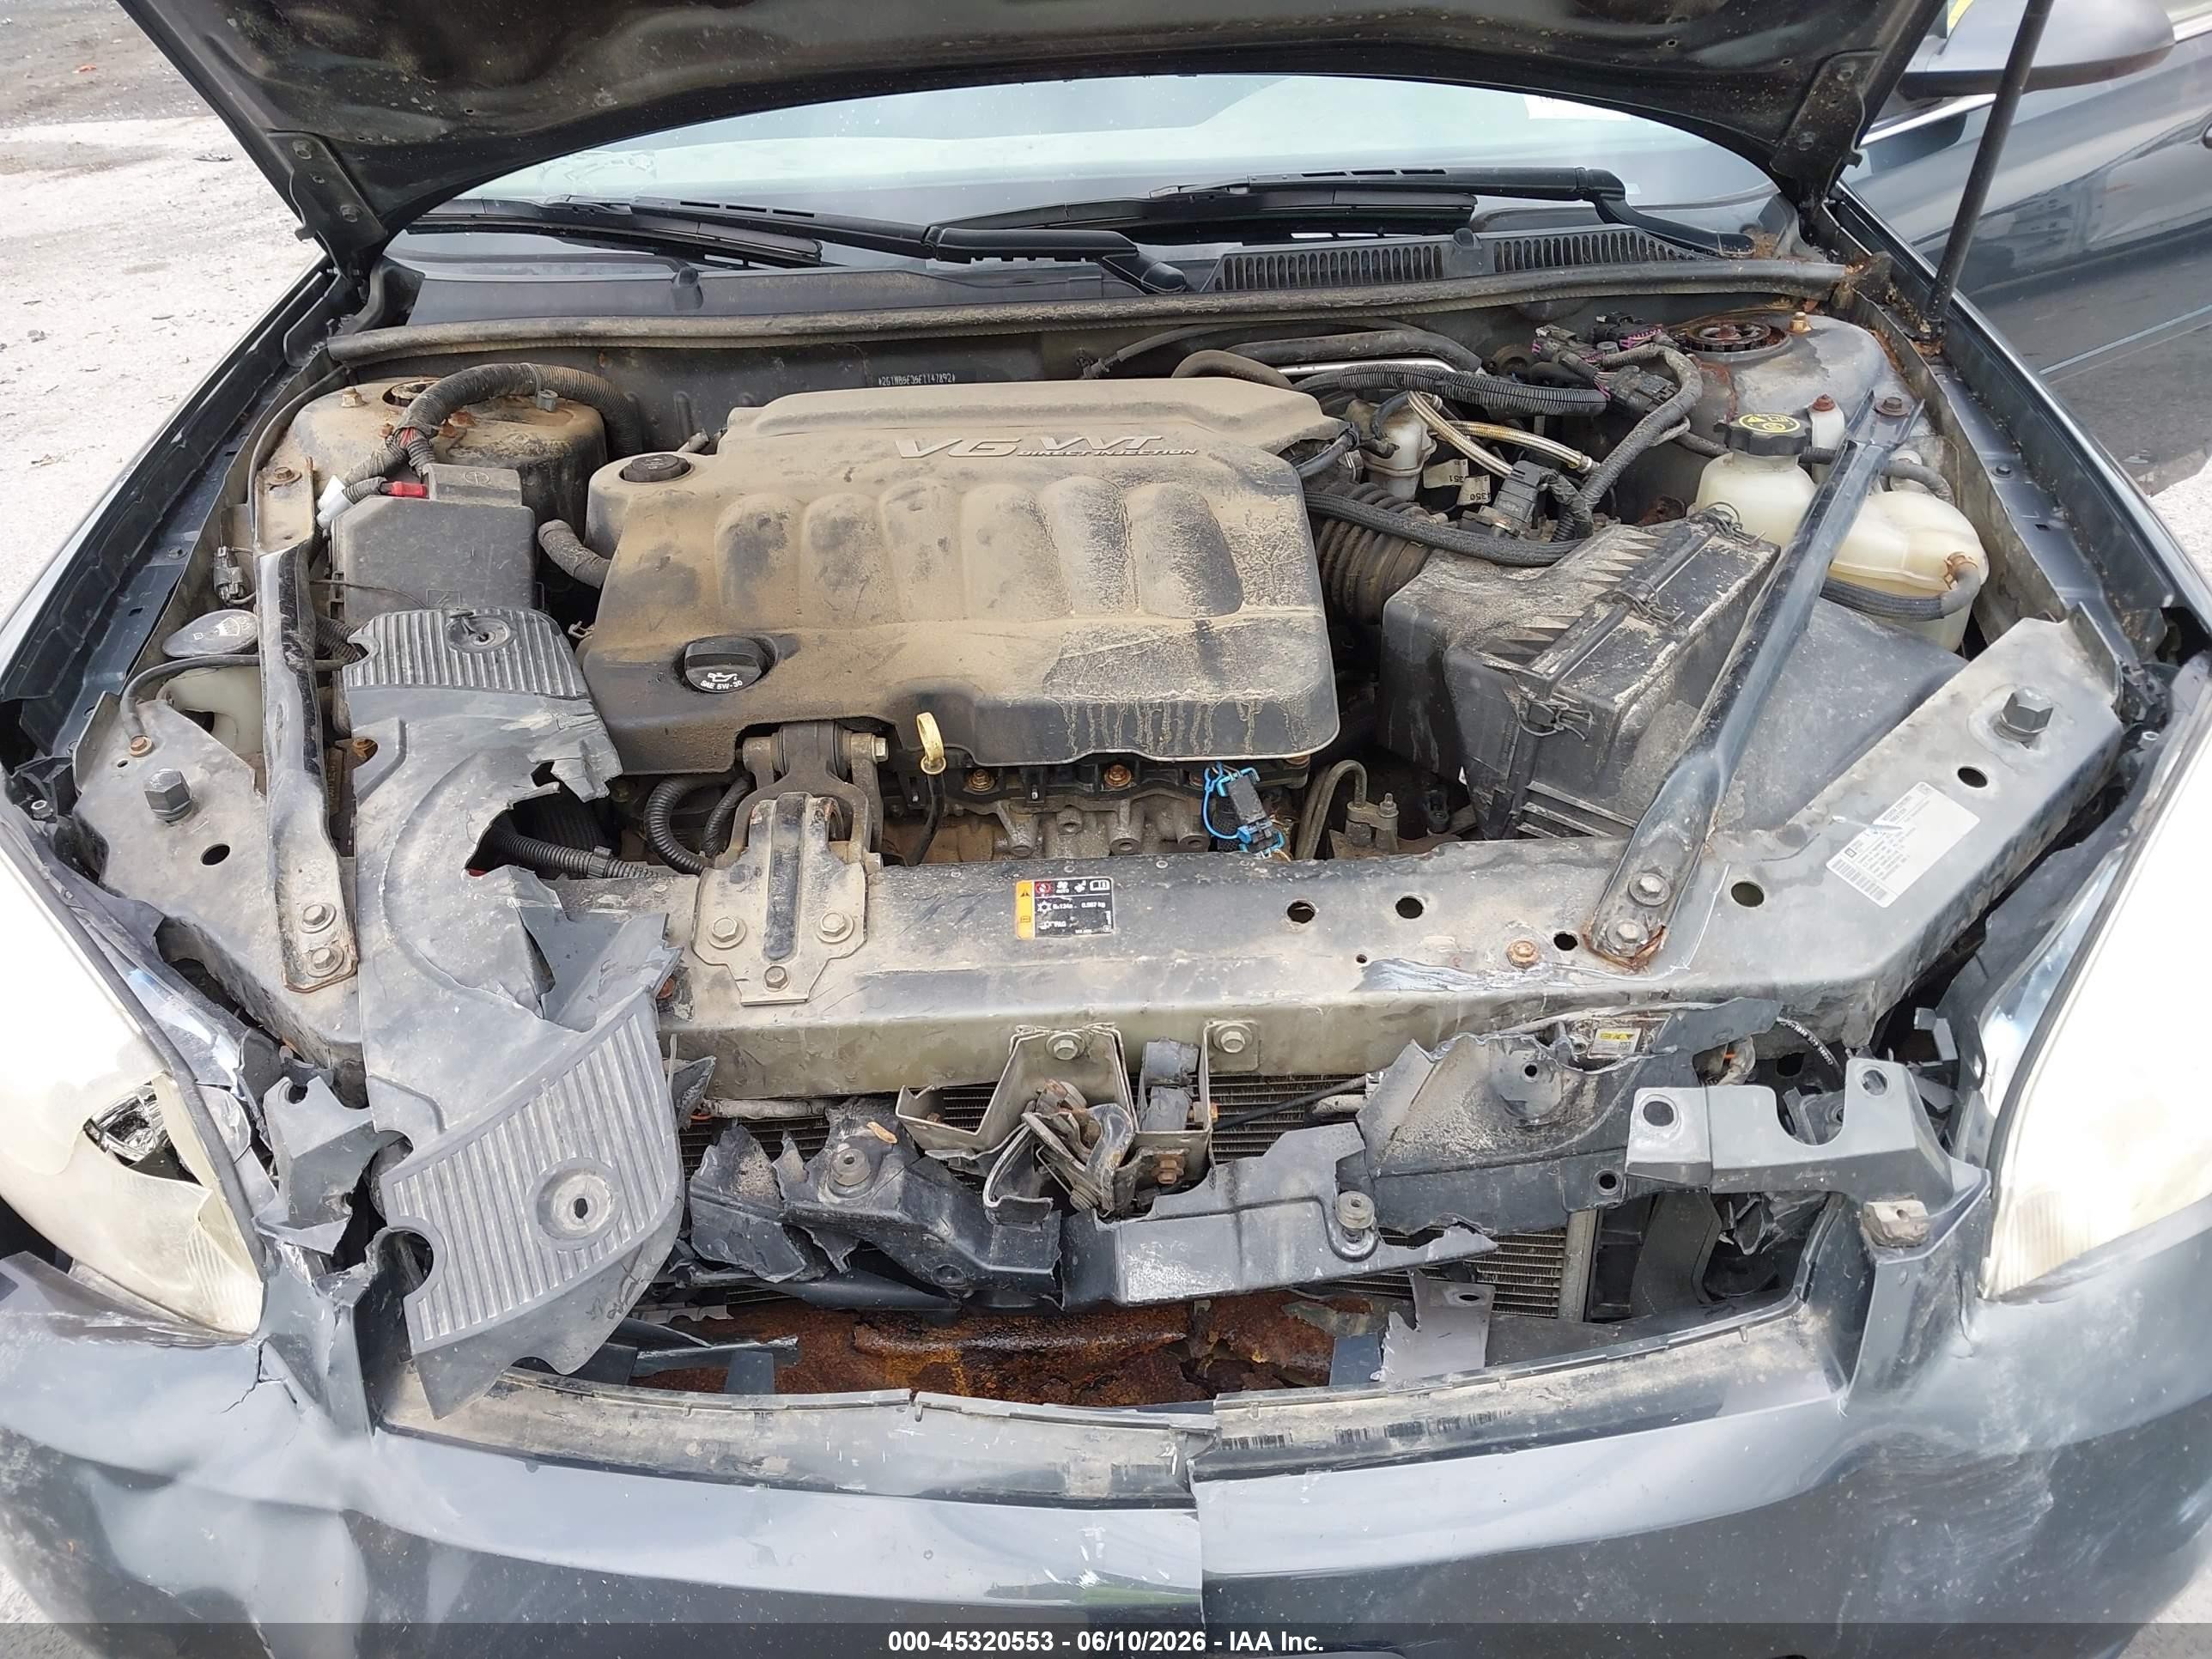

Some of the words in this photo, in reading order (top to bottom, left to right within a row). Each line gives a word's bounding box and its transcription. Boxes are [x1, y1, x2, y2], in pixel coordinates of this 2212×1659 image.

[895, 438, 1022, 459] V6
[1039, 435, 1164, 451] VVT
[1093, 447, 1198, 457] INJECTION
[700, 680, 715, 689] SAE
[716, 680, 743, 690] 5W-30
